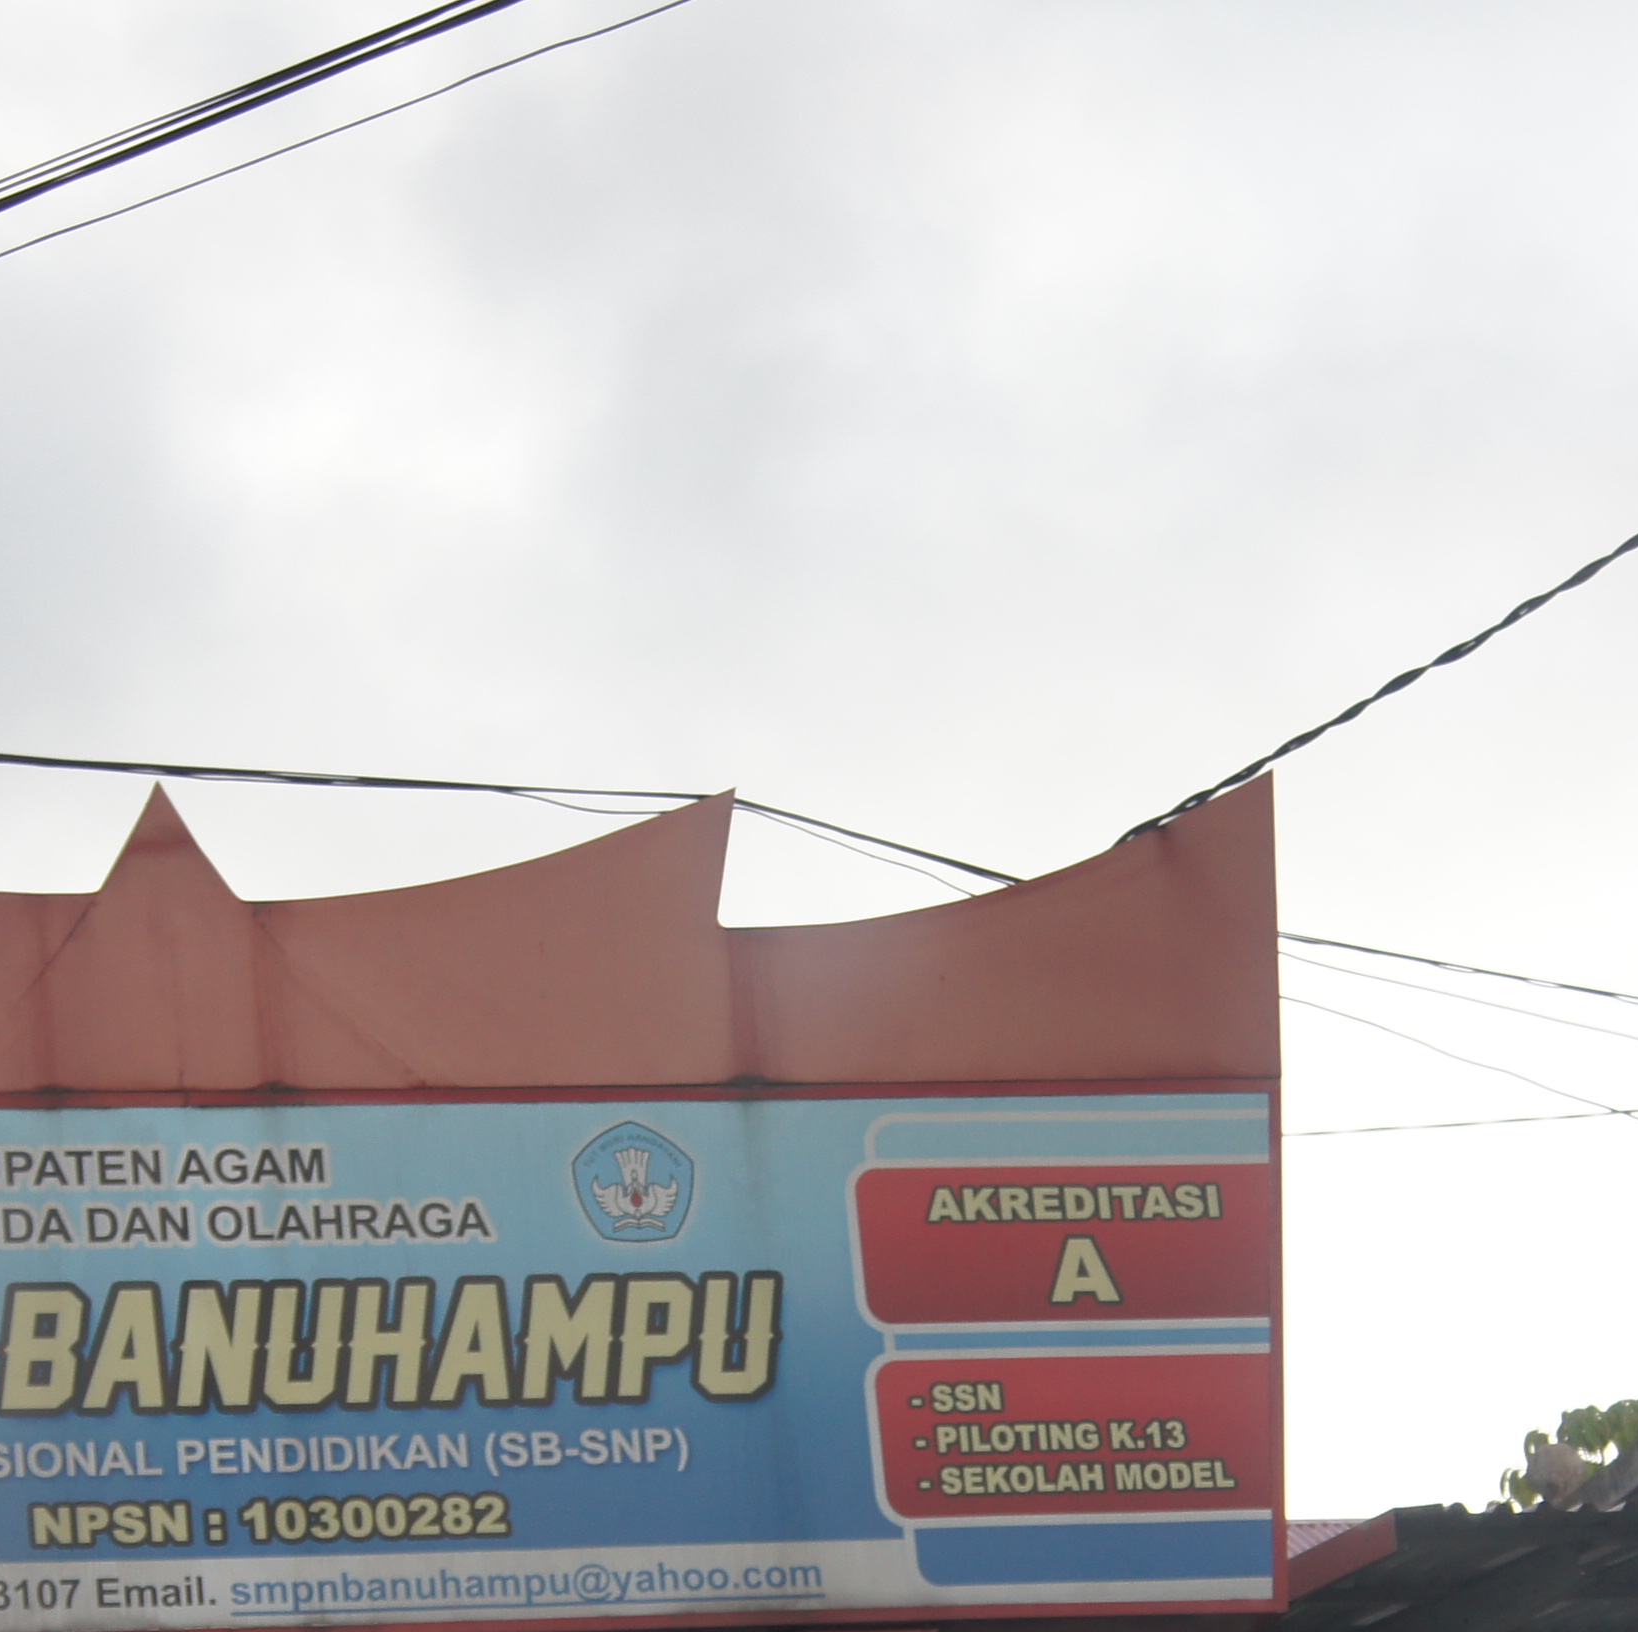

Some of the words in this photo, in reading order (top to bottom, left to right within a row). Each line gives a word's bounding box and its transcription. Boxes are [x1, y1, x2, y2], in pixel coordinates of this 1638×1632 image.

[178, 1146, 326, 1186] AGAM
[86, 1204, 191, 1243] DAN
[207, 1201, 491, 1242] OLAHRAGA
[927, 1183, 1223, 1224] AKREDITASI
[1048, 1235, 1123, 1306] A
[930, 1382, 1004, 1413] SSN
[176, 1433, 468, 1475] PENDIDIKAN
[484, 1427, 690, 1477] (SB-SNP)
[935, 1421, 1101, 1453] PILOTING
[1108, 1419, 1186, 1450] K.13
[940, 1463, 1105, 1495] SEKOLAH
[1113, 1459, 1236, 1491] MODEL
[30, 1501, 190, 1548] NPSN
[240, 1493, 510, 1543] 10300282
[97, 1574, 216, 1612] Email.
[231, 1559, 823, 1609] smpnbanuhampu@yahoo.com
